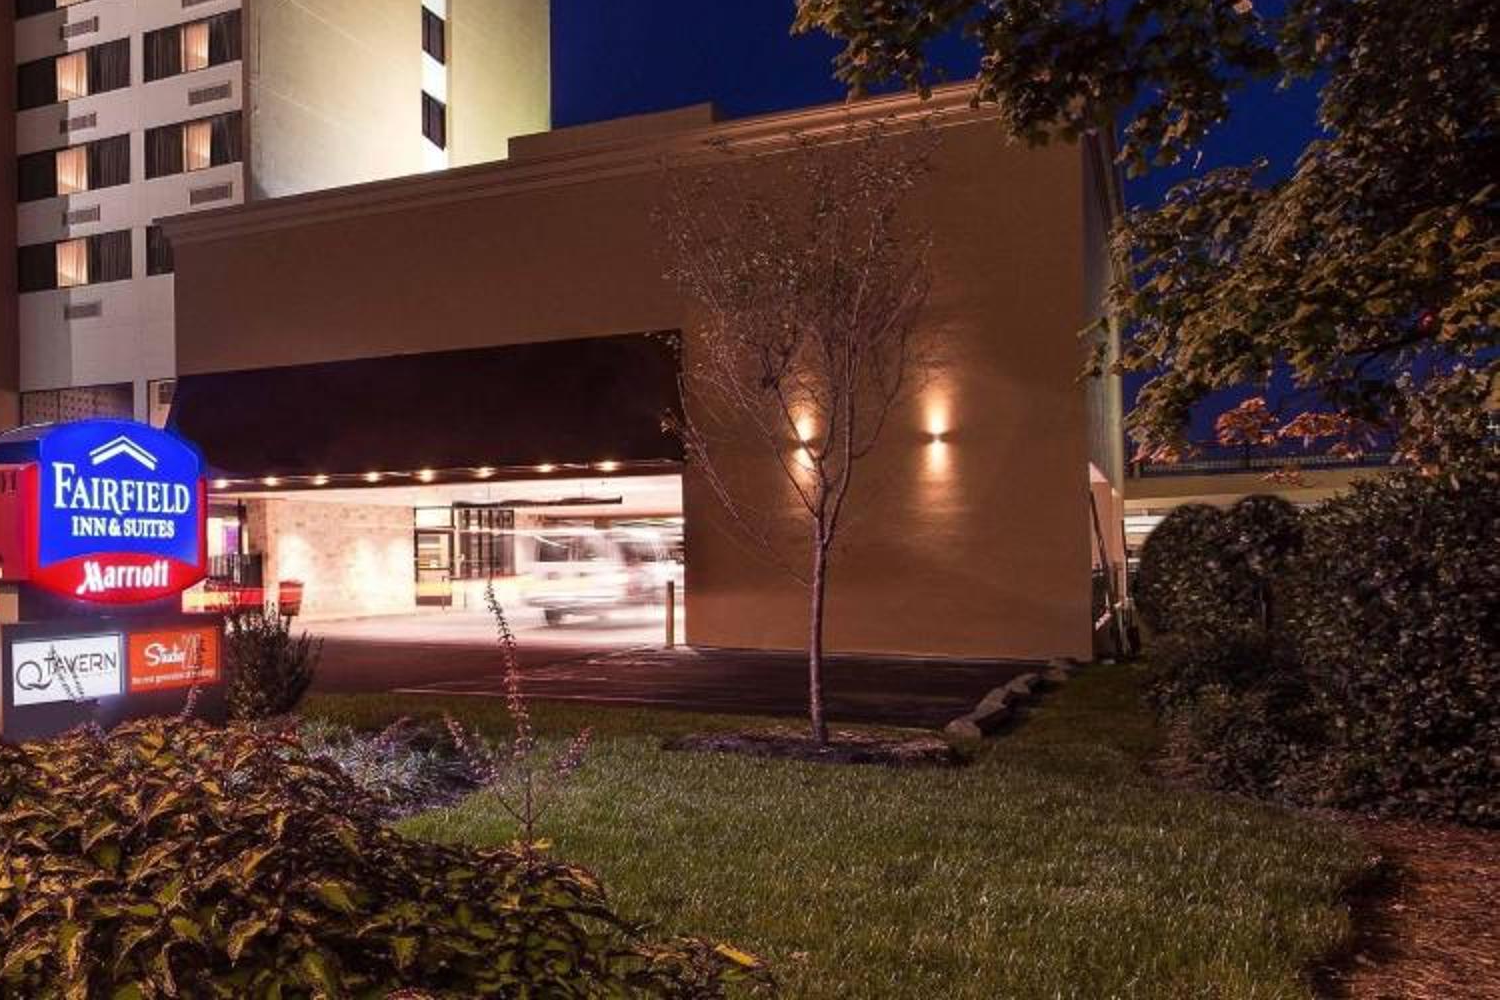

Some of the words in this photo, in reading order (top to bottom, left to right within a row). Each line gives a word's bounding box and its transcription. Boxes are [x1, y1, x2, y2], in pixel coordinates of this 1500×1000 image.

[51, 461, 190, 515] FAIRFIELD
[71, 515, 107, 537] INN
[108, 517, 121, 537] &
[123, 518, 175, 539] SUITES
[75, 560, 169, 595] Marriott
